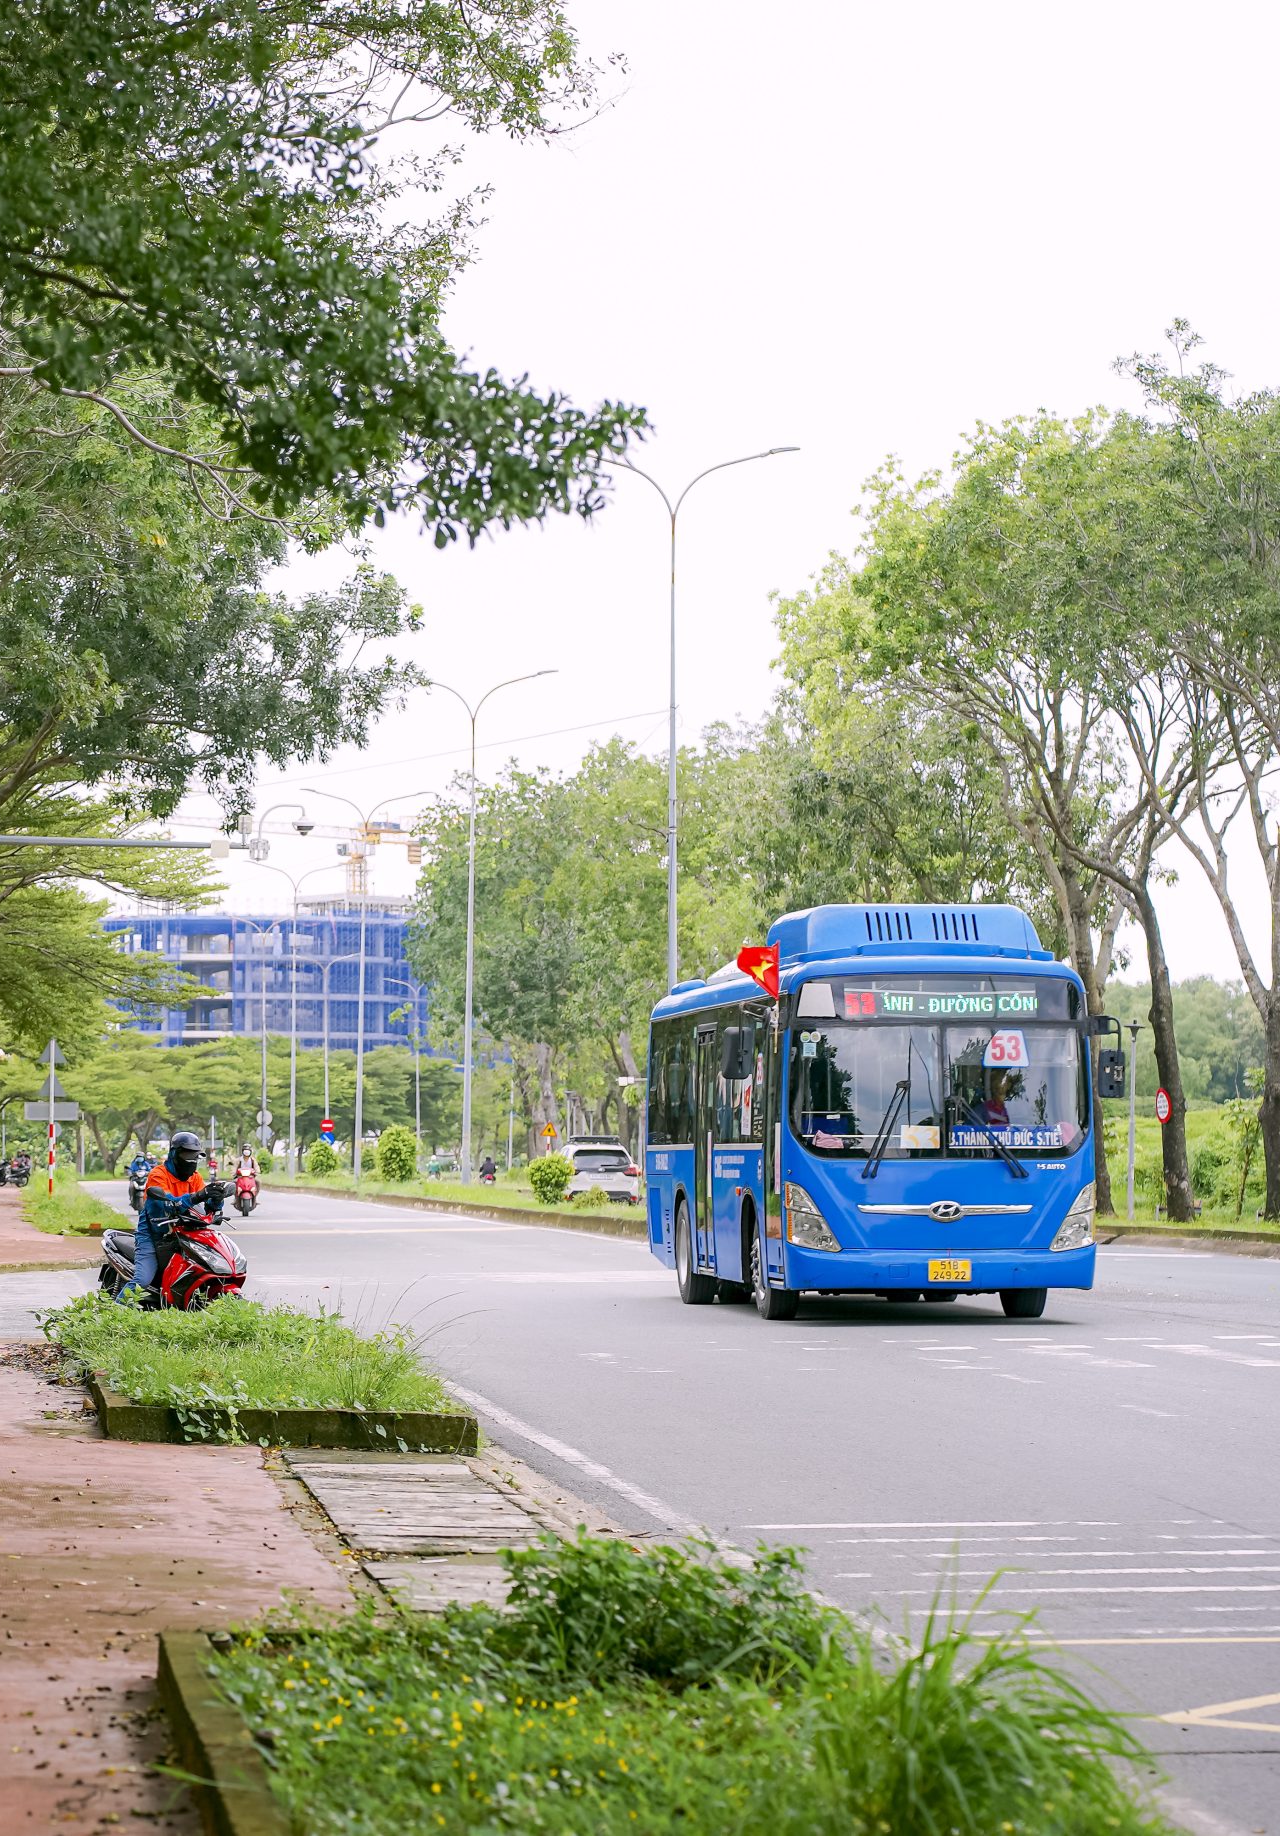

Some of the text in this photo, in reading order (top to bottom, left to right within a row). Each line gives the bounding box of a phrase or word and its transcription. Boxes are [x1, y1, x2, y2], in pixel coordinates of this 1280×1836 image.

[844, 992, 876, 1016] 53
[928, 994, 993, 1013] ĐƯỜNG
[991, 1035, 1021, 1061] 53
[1014, 1127, 1034, 1146] ĐỨC
[940, 1260, 959, 1270] 51B
[933, 1270, 967, 1280] 249.22
